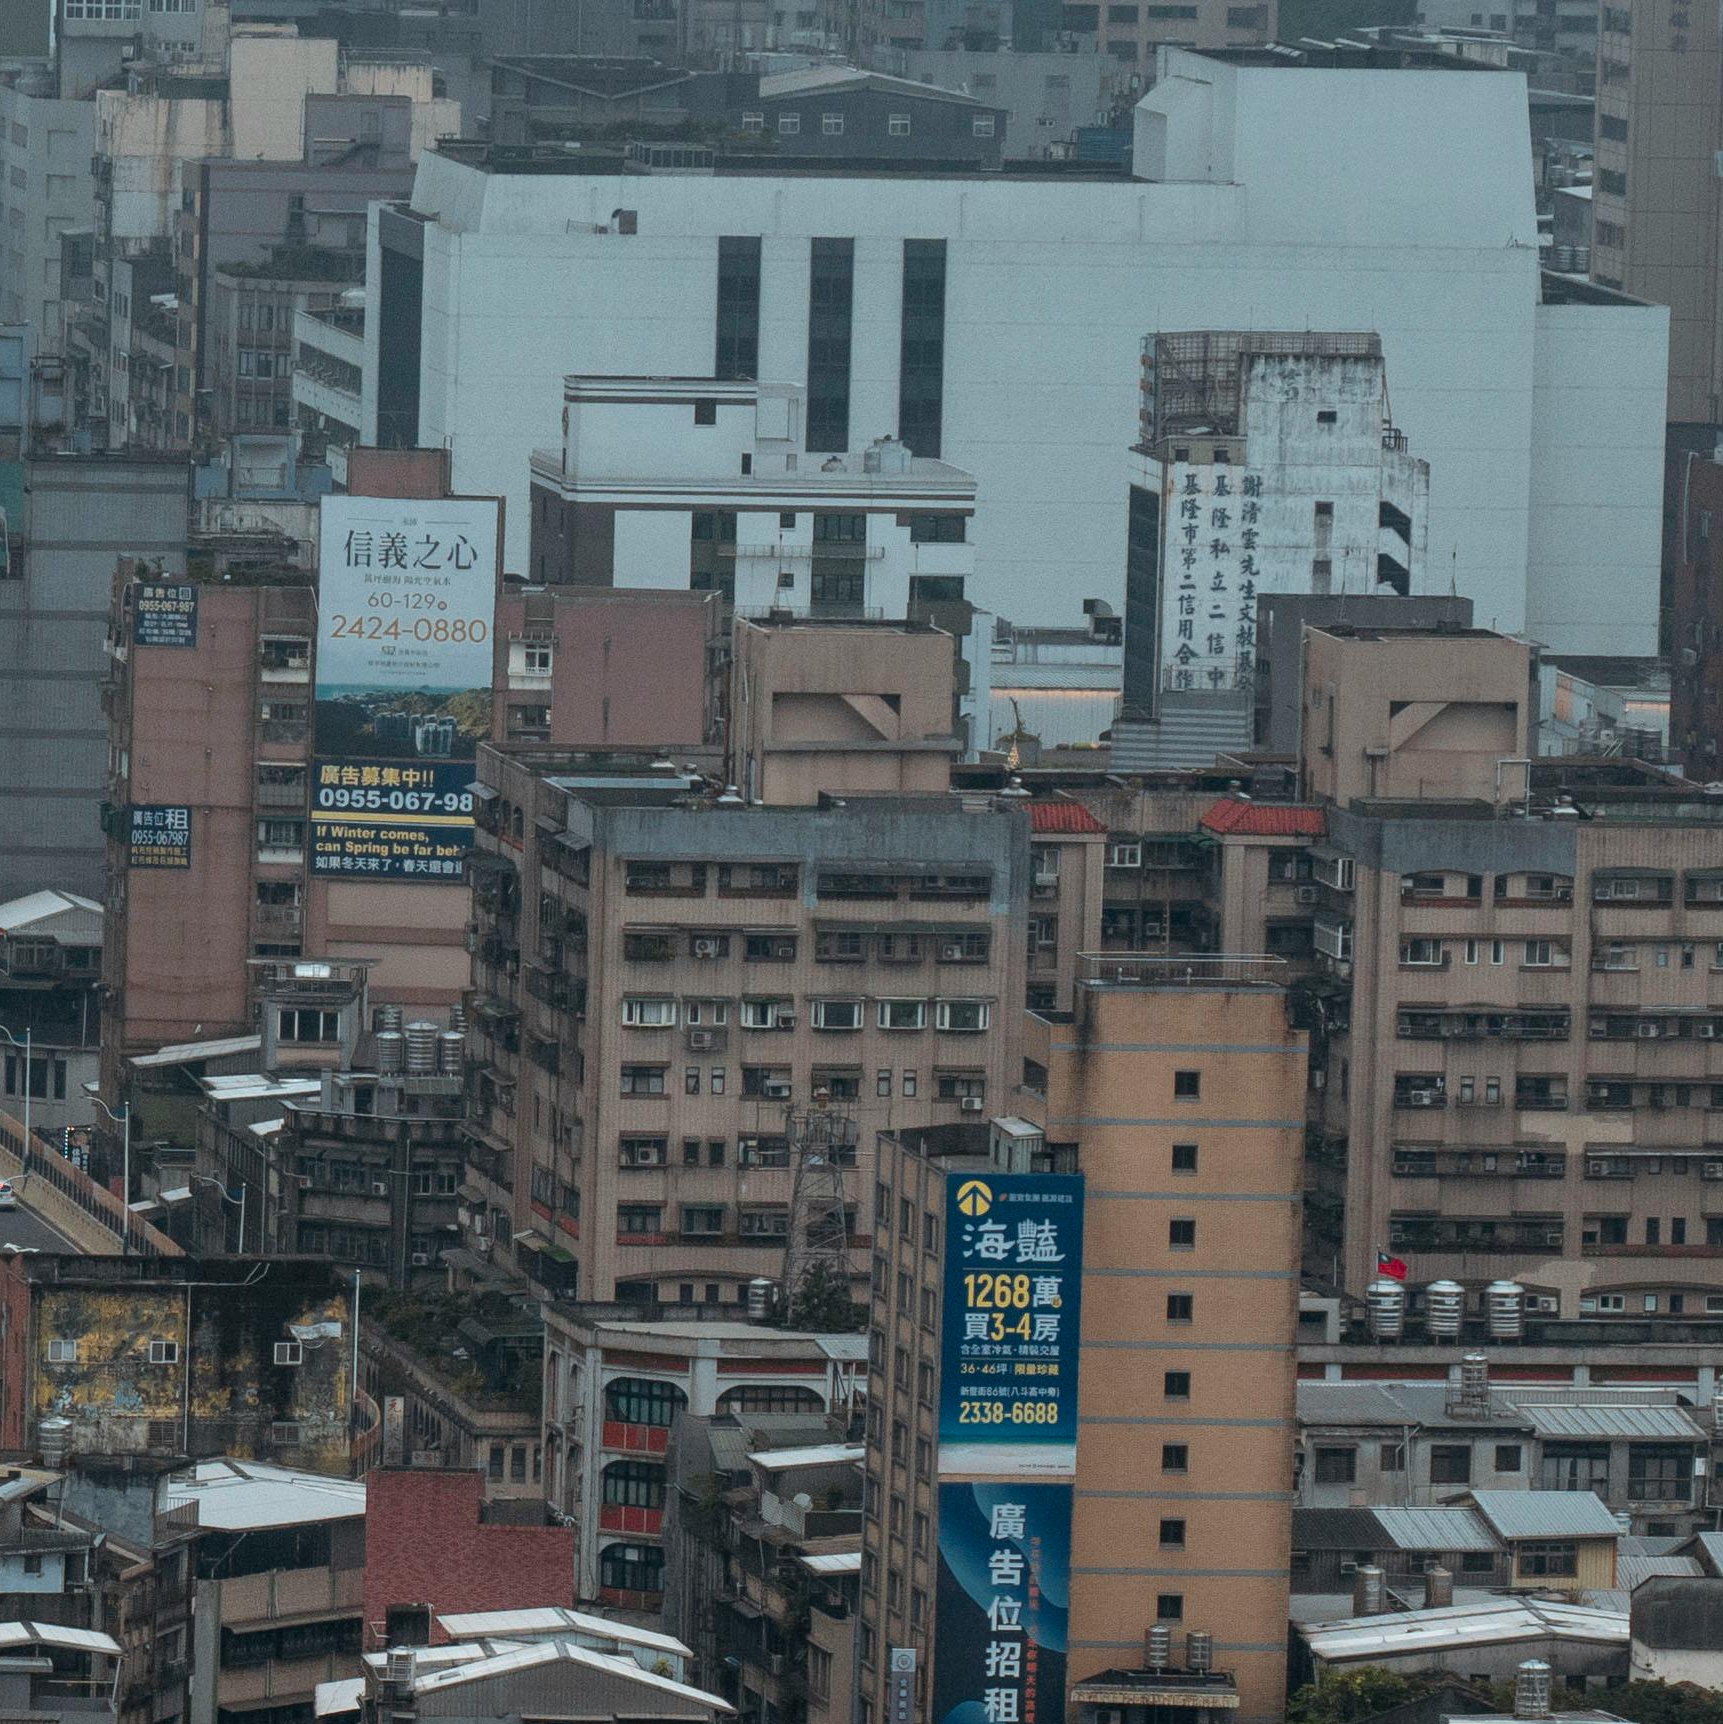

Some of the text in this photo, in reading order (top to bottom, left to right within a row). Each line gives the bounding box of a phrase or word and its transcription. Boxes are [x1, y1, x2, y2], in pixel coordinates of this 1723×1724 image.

[344, 529, 478, 570] 信義之心
[1207, 475, 1232, 688] 基隆私立二信中
[368, 592, 436, 609] 60-129
[331, 614, 487, 643] 2424-0880
[320, 765, 435, 788] 廣告募集中!!
[132, 830, 189, 846] 0955-067987
[316, 826, 429, 843] If Winter comes,
[315, 841, 465, 856] can Spring be far beh
[964, 1273, 1063, 1309] 1268萬
[963, 1312, 1060, 1342] 買3-4房
[1015, 1364, 1060, 1376] 限量珍藏
[959, 1401, 1058, 1424] 2338-6688
[984, 1503, 1026, 1723] 廣告位招租
